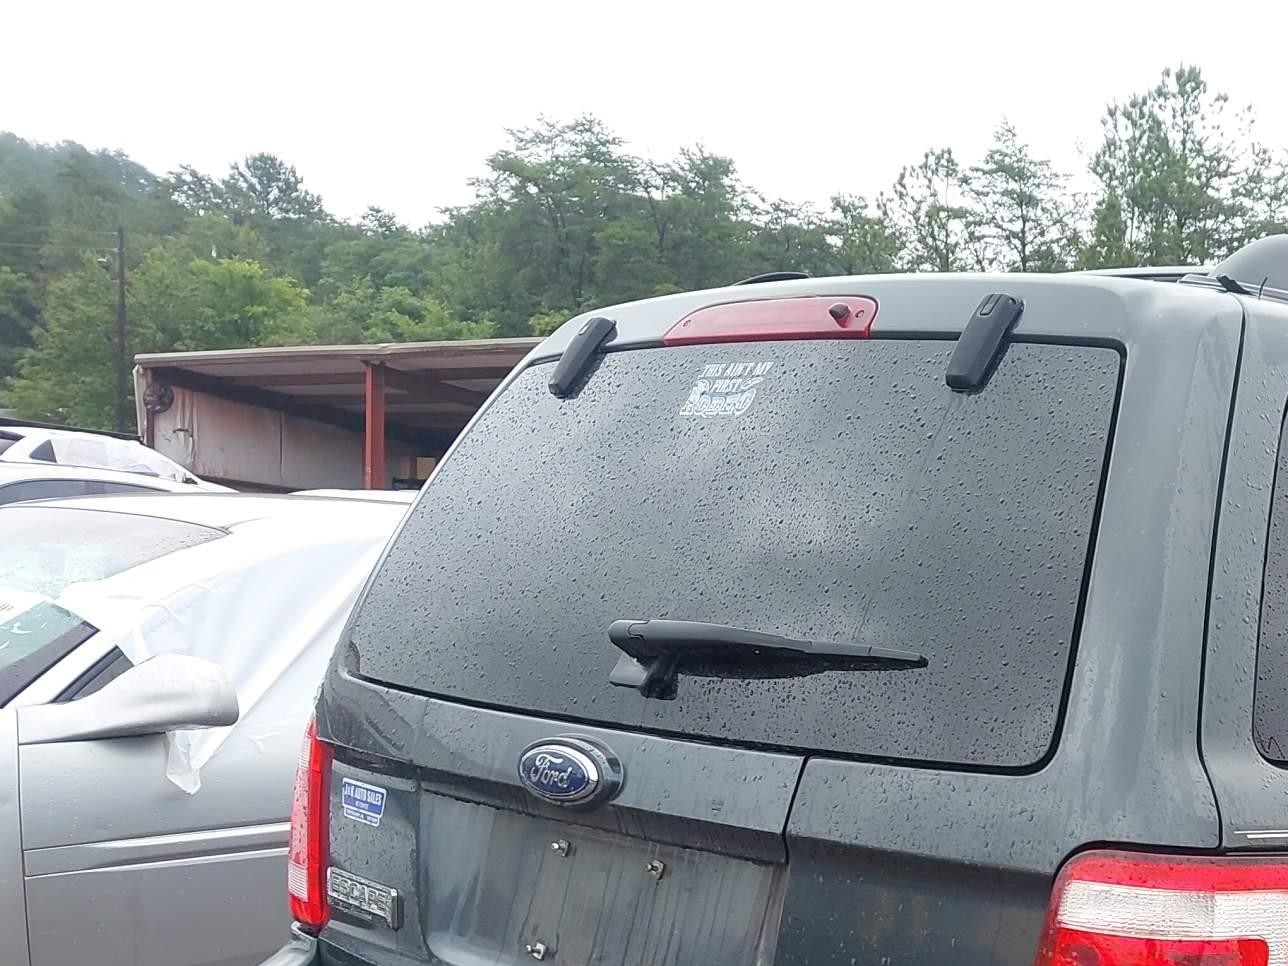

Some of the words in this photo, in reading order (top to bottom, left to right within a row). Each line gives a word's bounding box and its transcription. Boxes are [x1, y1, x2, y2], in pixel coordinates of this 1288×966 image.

[699, 364, 726, 377] THIS
[752, 362, 773, 375] MY
[711, 379, 742, 392] FIRST
[680, 388, 756, 417] RODEO
[530, 754, 573, 788] Ford
[355, 787, 367, 801] AUTO
[367, 791, 382, 806] SALES
[332, 873, 386, 911] ESCAPE
